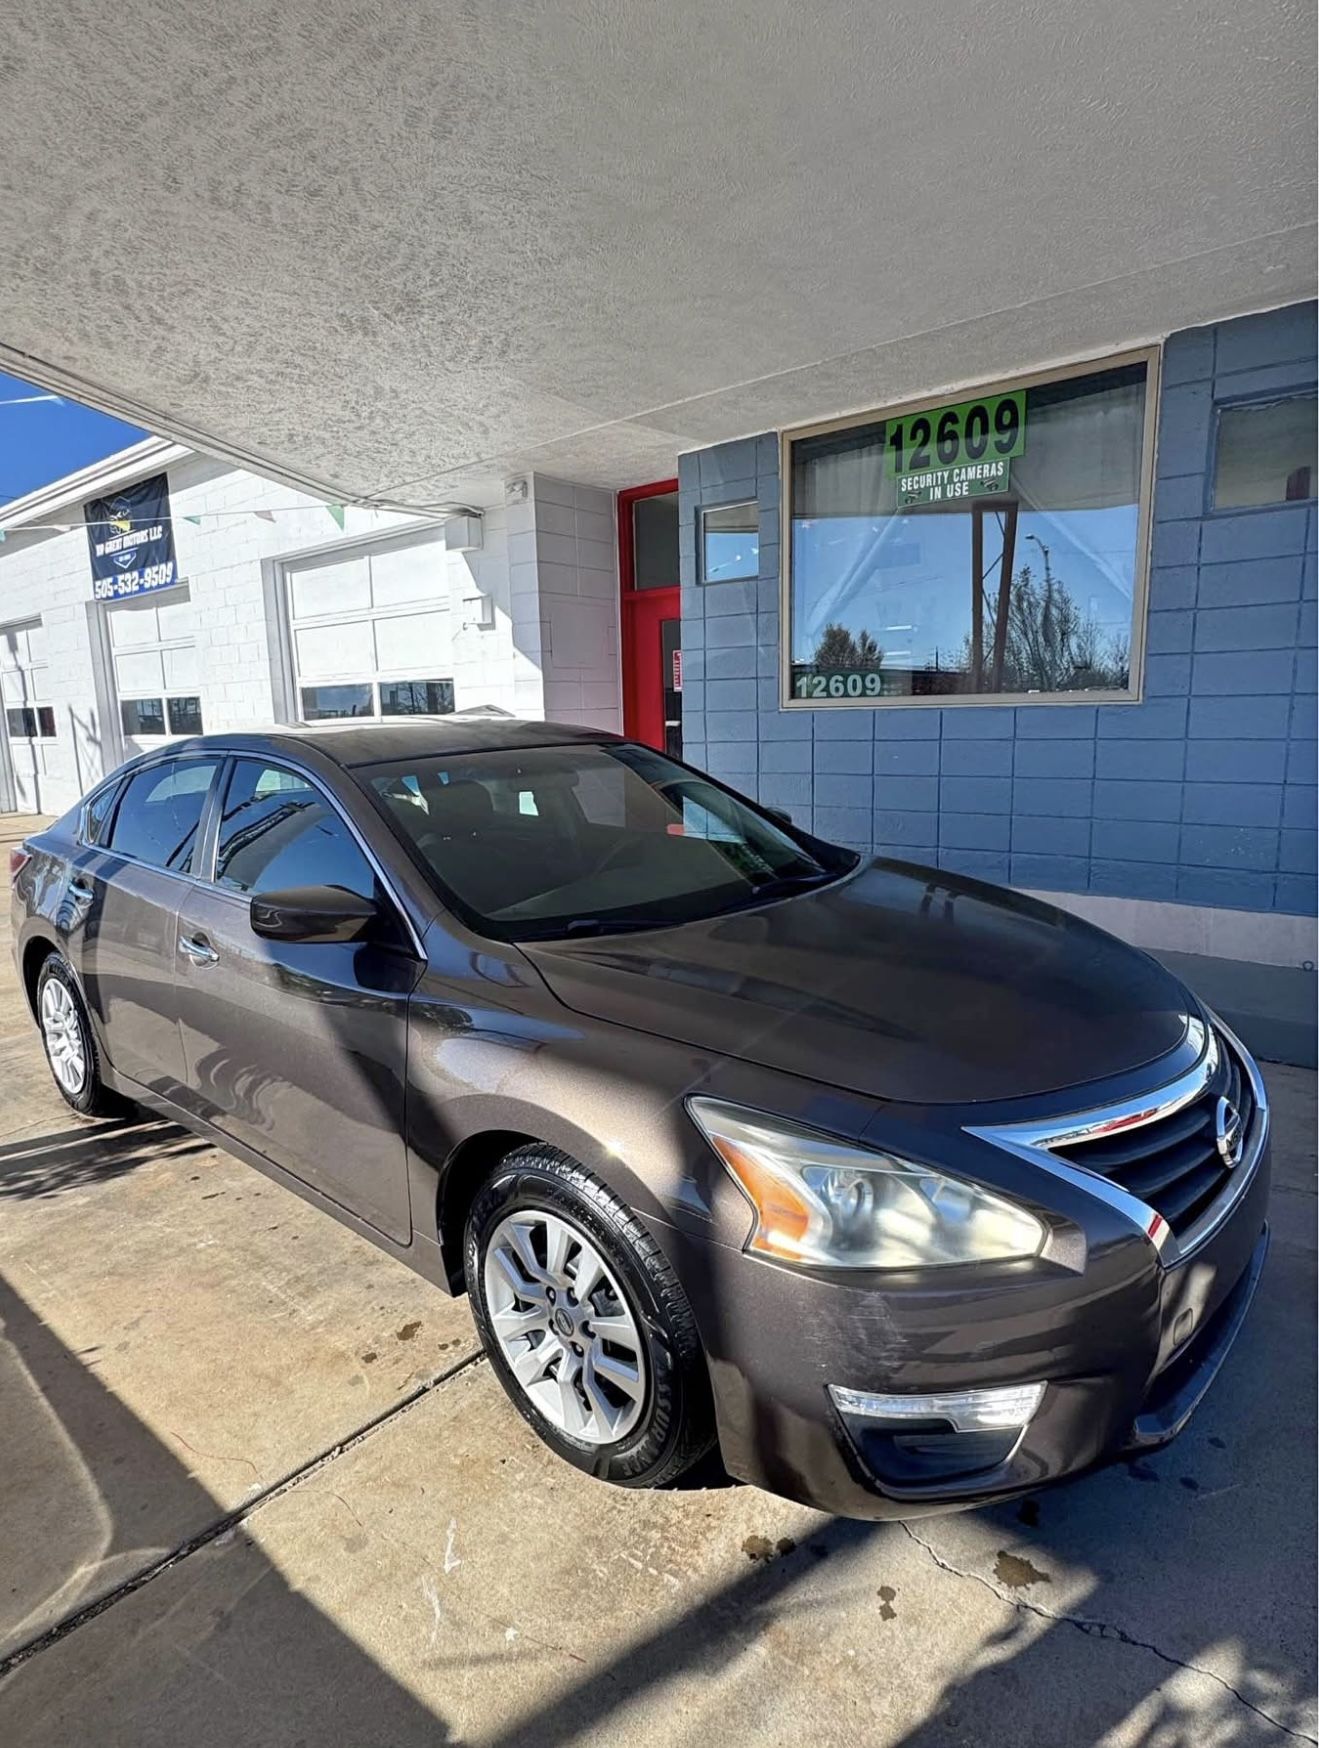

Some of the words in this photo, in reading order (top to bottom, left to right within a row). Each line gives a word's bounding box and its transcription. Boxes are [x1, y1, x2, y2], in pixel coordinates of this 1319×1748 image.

[890, 398, 1019, 473] 12609
[901, 470, 950, 492] SECURITY
[953, 462, 1004, 481] CAMERAS
[930, 486, 942, 500] IN
[946, 482, 969, 498] USE
[150, 526, 162, 540] LLC
[95, 562, 173, 599] 505-532-9509
[796, 673, 881, 698] 12609
